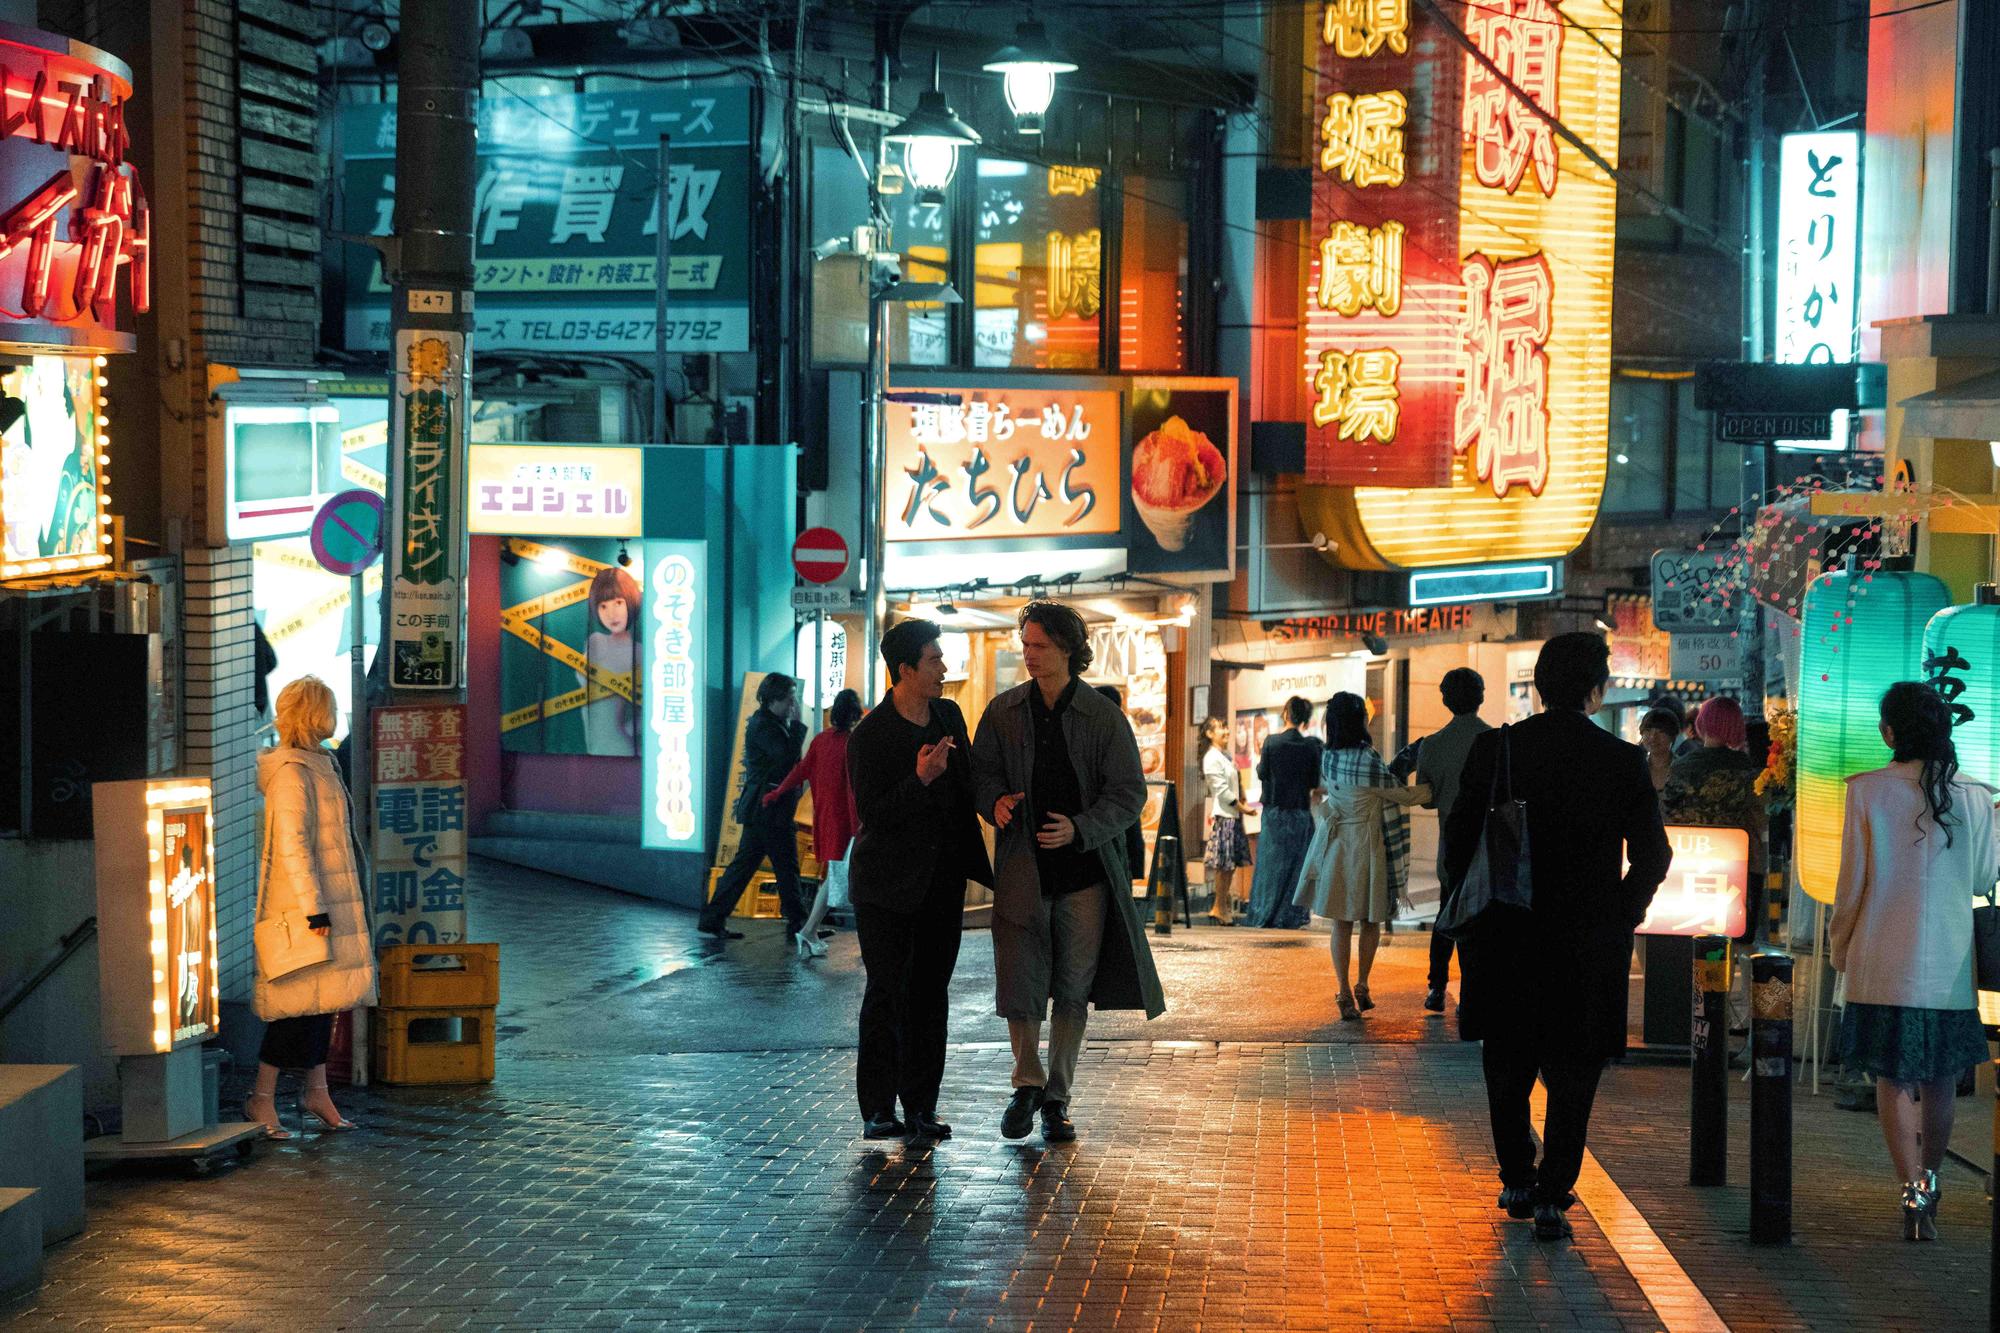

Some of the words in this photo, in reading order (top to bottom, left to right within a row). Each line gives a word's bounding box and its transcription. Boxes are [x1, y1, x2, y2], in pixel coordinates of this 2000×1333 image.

[421, 295, 445, 306] 47
[1728, 416, 1776, 435] OPEN
[1783, 416, 1826, 435] DISH
[904, 446, 1096, 529] たちひら
[396, 614, 450, 628] この手前
[1282, 617, 1339, 642] STRIP
[1344, 610, 1386, 639] LIVE
[1394, 604, 1473, 634] THEATER
[378, 709, 462, 741] 無審査
[377, 743, 465, 781] 融資
[376, 785, 465, 834] 電話
[402, 834, 439, 868] で
[1676, 834, 1712, 852] UB
[376, 866, 465, 915] 即金
